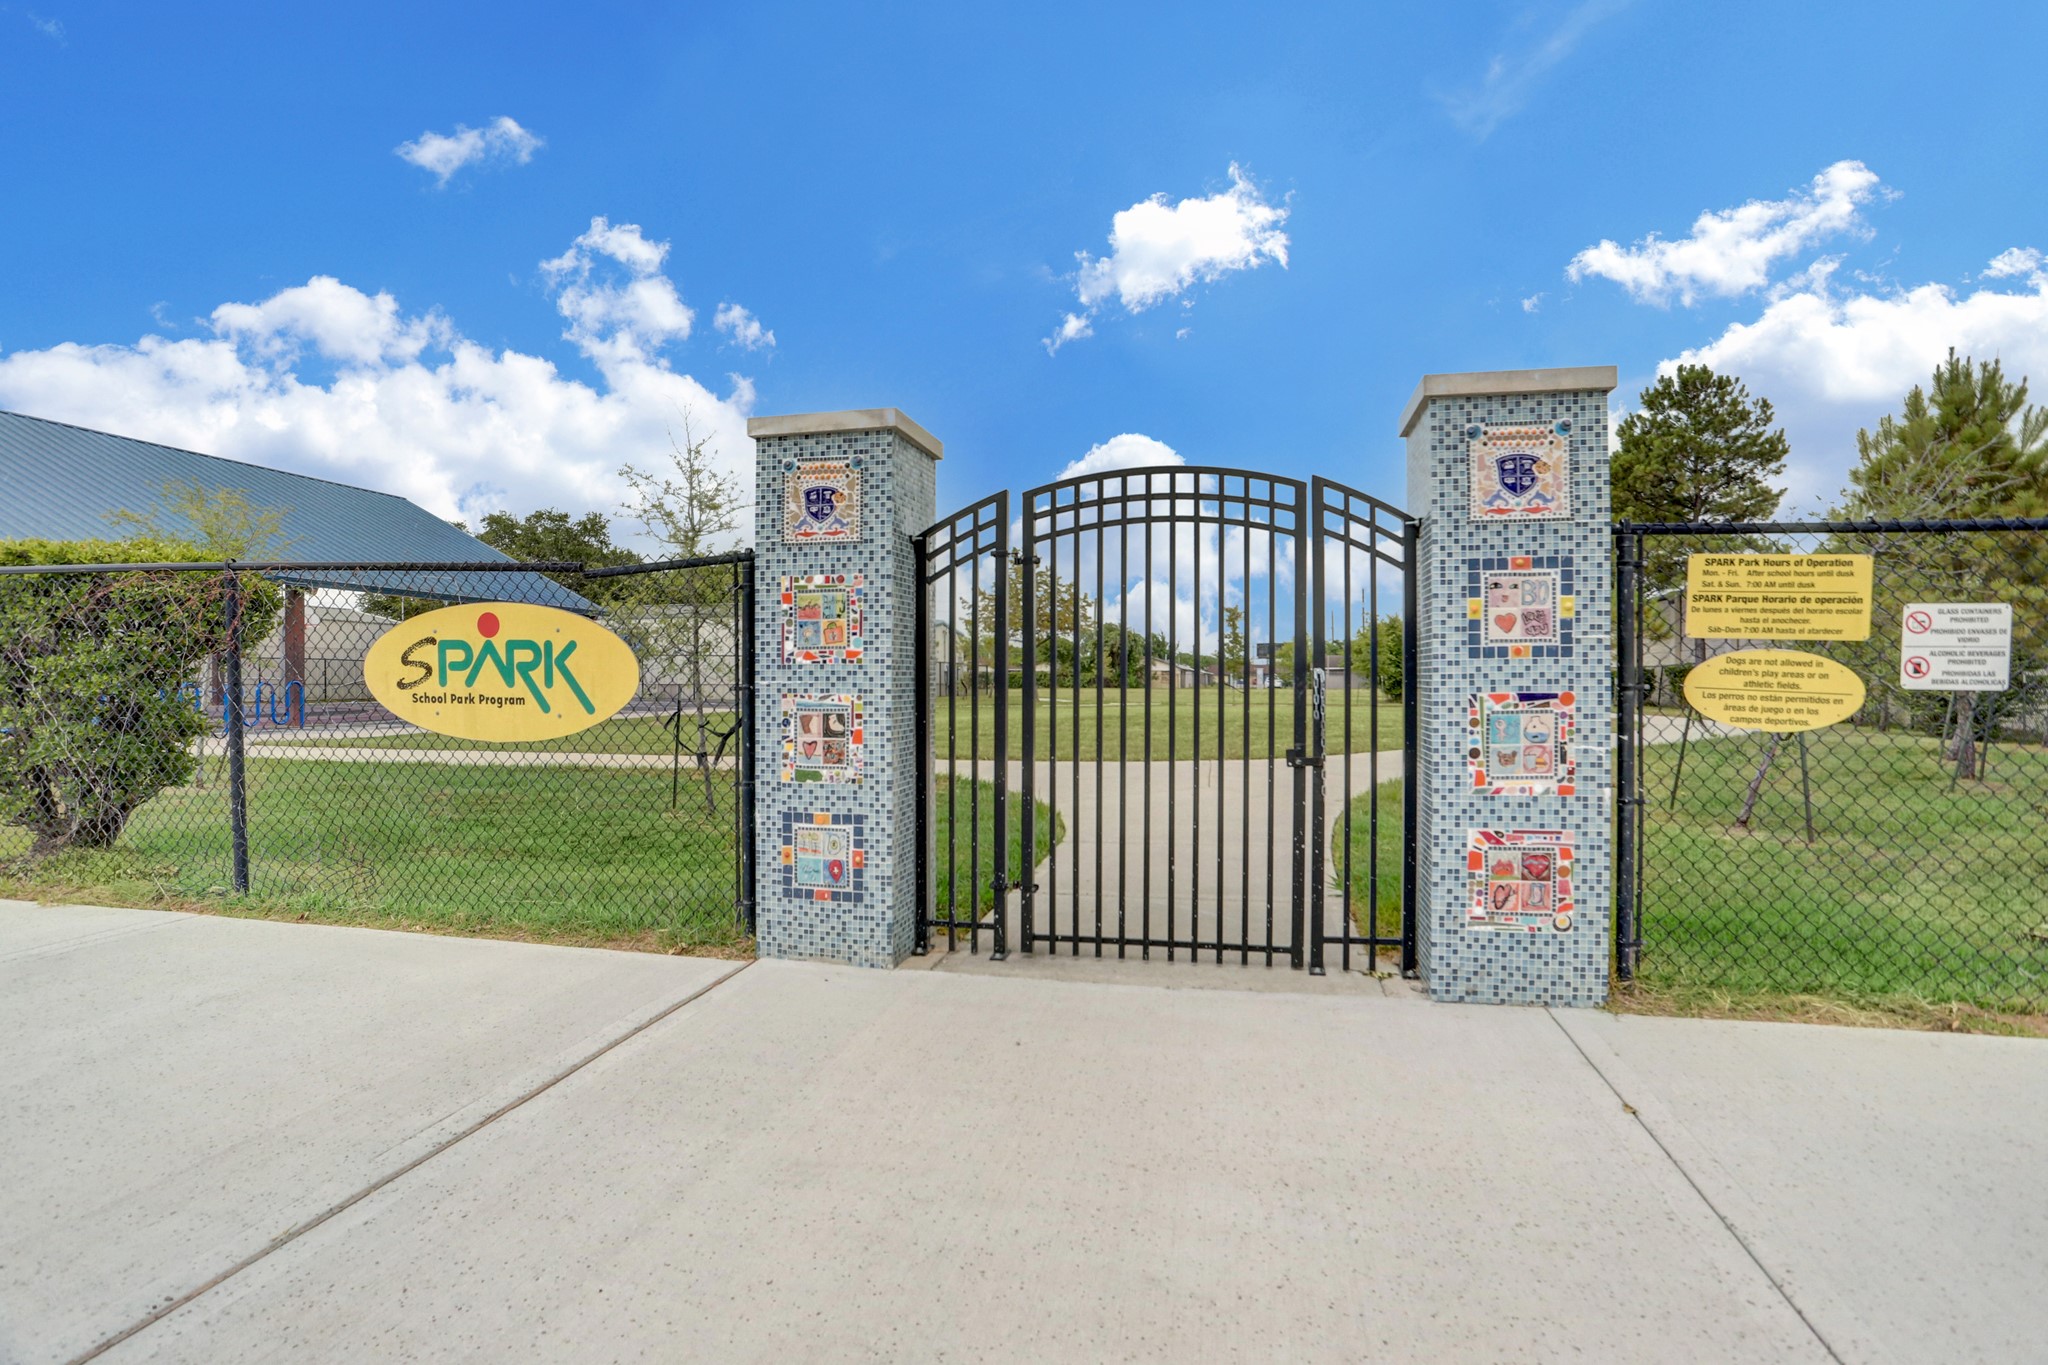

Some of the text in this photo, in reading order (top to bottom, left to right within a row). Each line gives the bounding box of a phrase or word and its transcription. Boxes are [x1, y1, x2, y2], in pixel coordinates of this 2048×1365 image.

[1705, 559, 1853, 568] SPARK Park Hours of Operation
[1692, 595, 1863, 605] SPARK Parque Horario de operación
[1760, 607, 1790, 615] después
[1726, 656, 1746, 666] Dogs
[1780, 659, 1813, 667] allowed
[1815, 660, 1823, 668] in
[396, 636, 596, 715] SPARK
[1762, 670, 1779, 679] play
[1744, 680, 1802, 690] athletic fields.
[412, 692, 526, 708] School Park Program
[1719, 693, 1745, 702] perros
[1760, 694, 1782, 702] están
[1785, 695, 1830, 705] permitidos
[1723, 704, 1746, 712] áreas
[1748, 704, 1758, 712] de
[1761, 705, 1784, 715] juego
[1807, 707, 1819, 715] los
[1730, 716, 1811, 727] campos deportivos.
